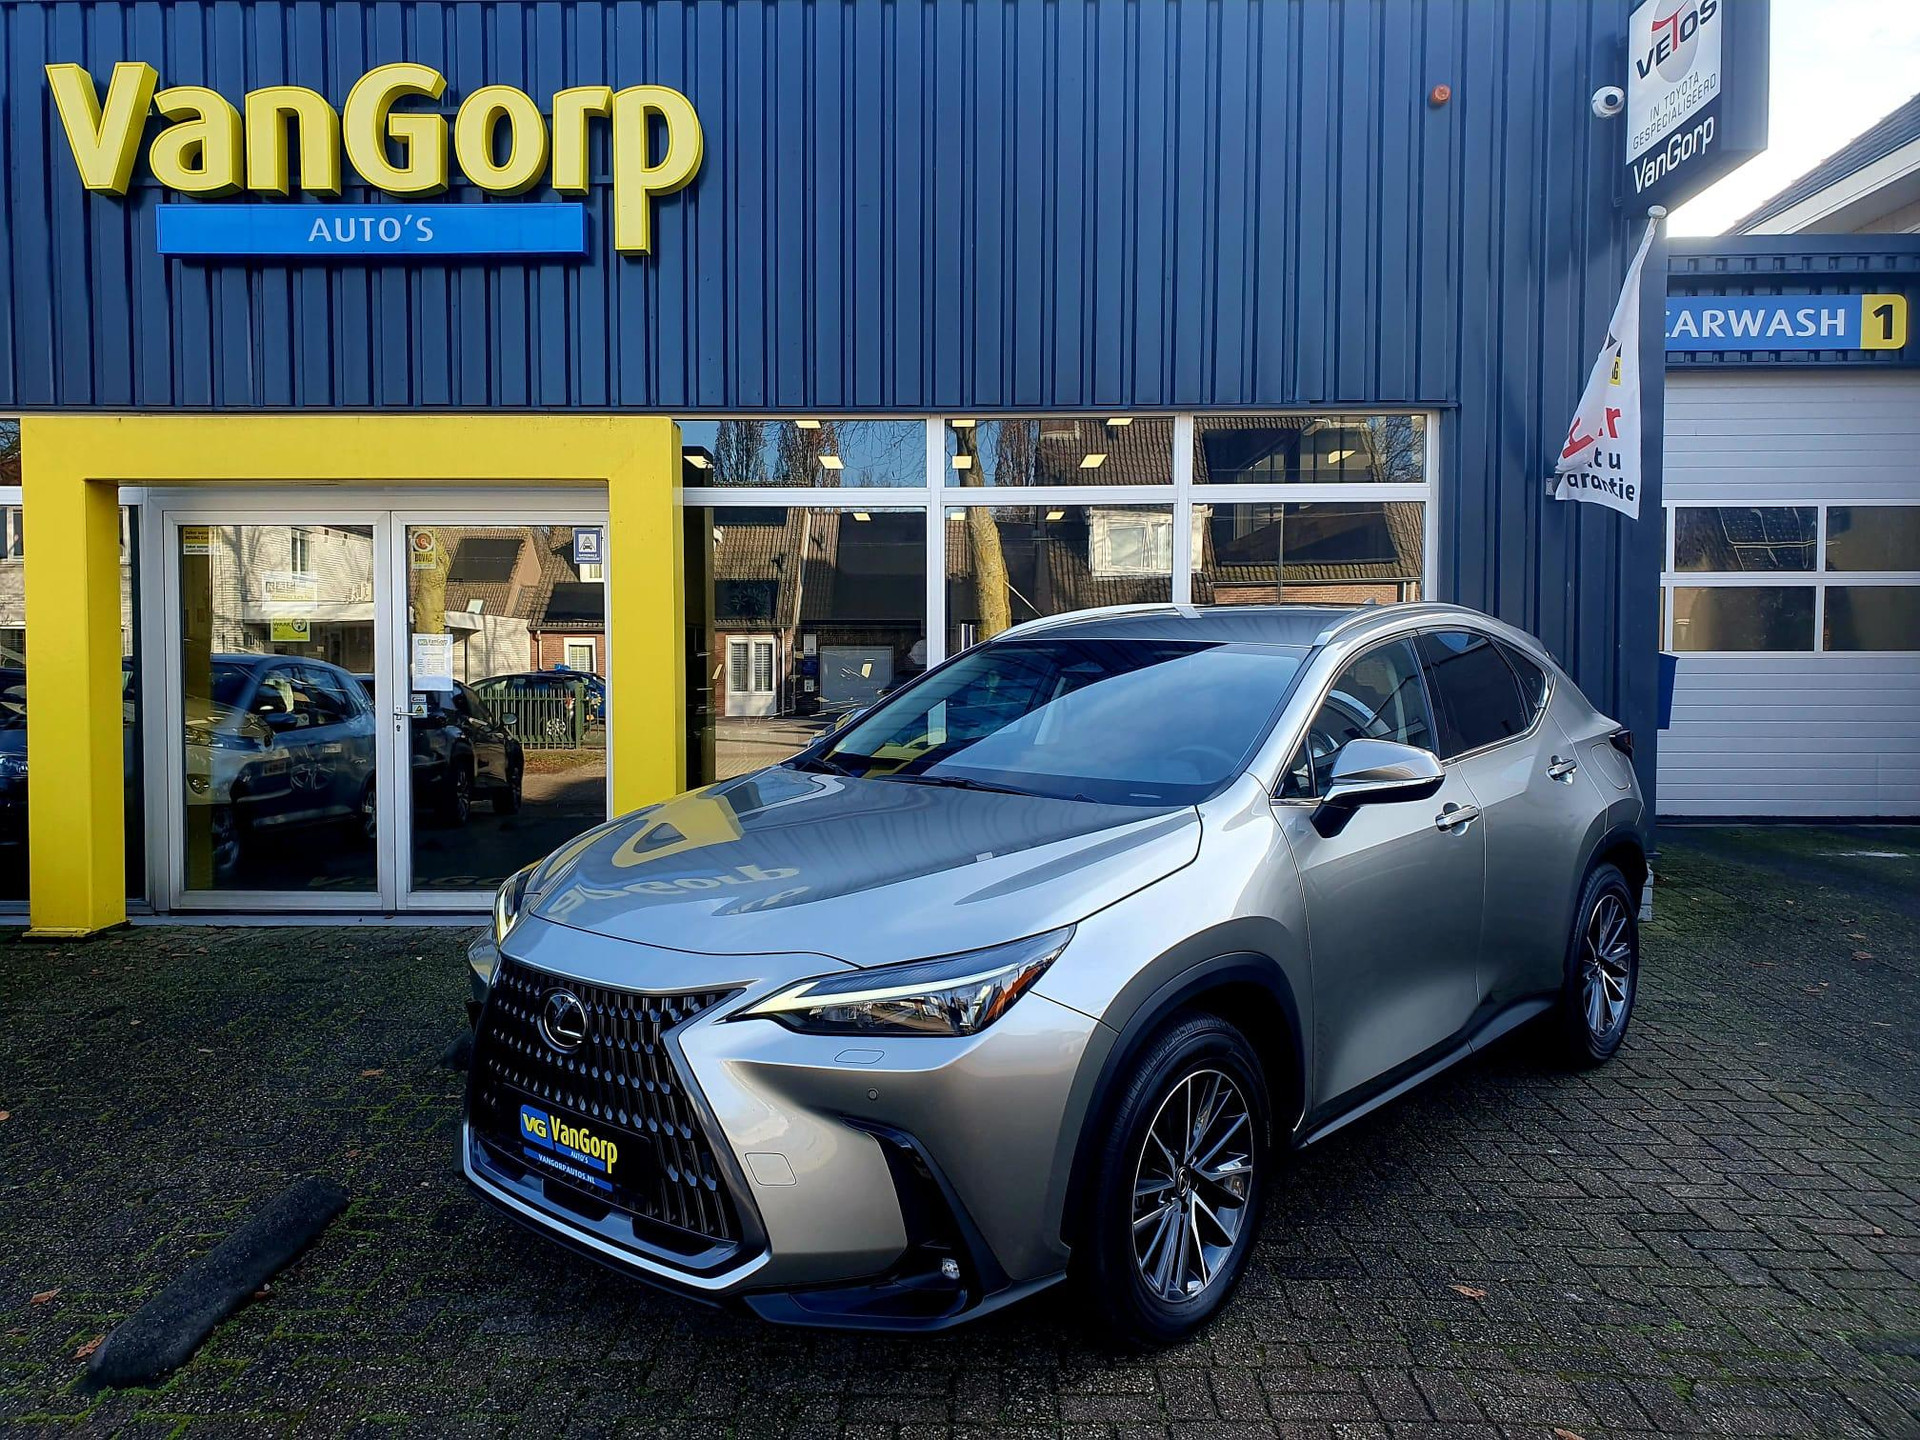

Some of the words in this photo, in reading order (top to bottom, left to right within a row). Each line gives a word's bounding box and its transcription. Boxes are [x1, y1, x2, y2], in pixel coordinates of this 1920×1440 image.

[1636, 0, 1717, 79] VETOS
[1632, 72, 1716, 150] GESPECIALISEERD
[1650, 102, 1660, 121] IN
[1664, 71, 1699, 110] TOYOTA
[45, 62, 704, 256] VanGorp
[1633, 116, 1714, 194] VanGorp
[308, 215, 434, 244] AUTO'S
[1872, 304, 1893, 340] 1
[1608, 452, 1621, 470] u
[1567, 472, 1635, 502] arantie
[522, 1113, 547, 1138] VG
[550, 1115, 618, 1174] VanGorp
[538, 1153, 596, 1185] VANGORPAUTOS.NL
